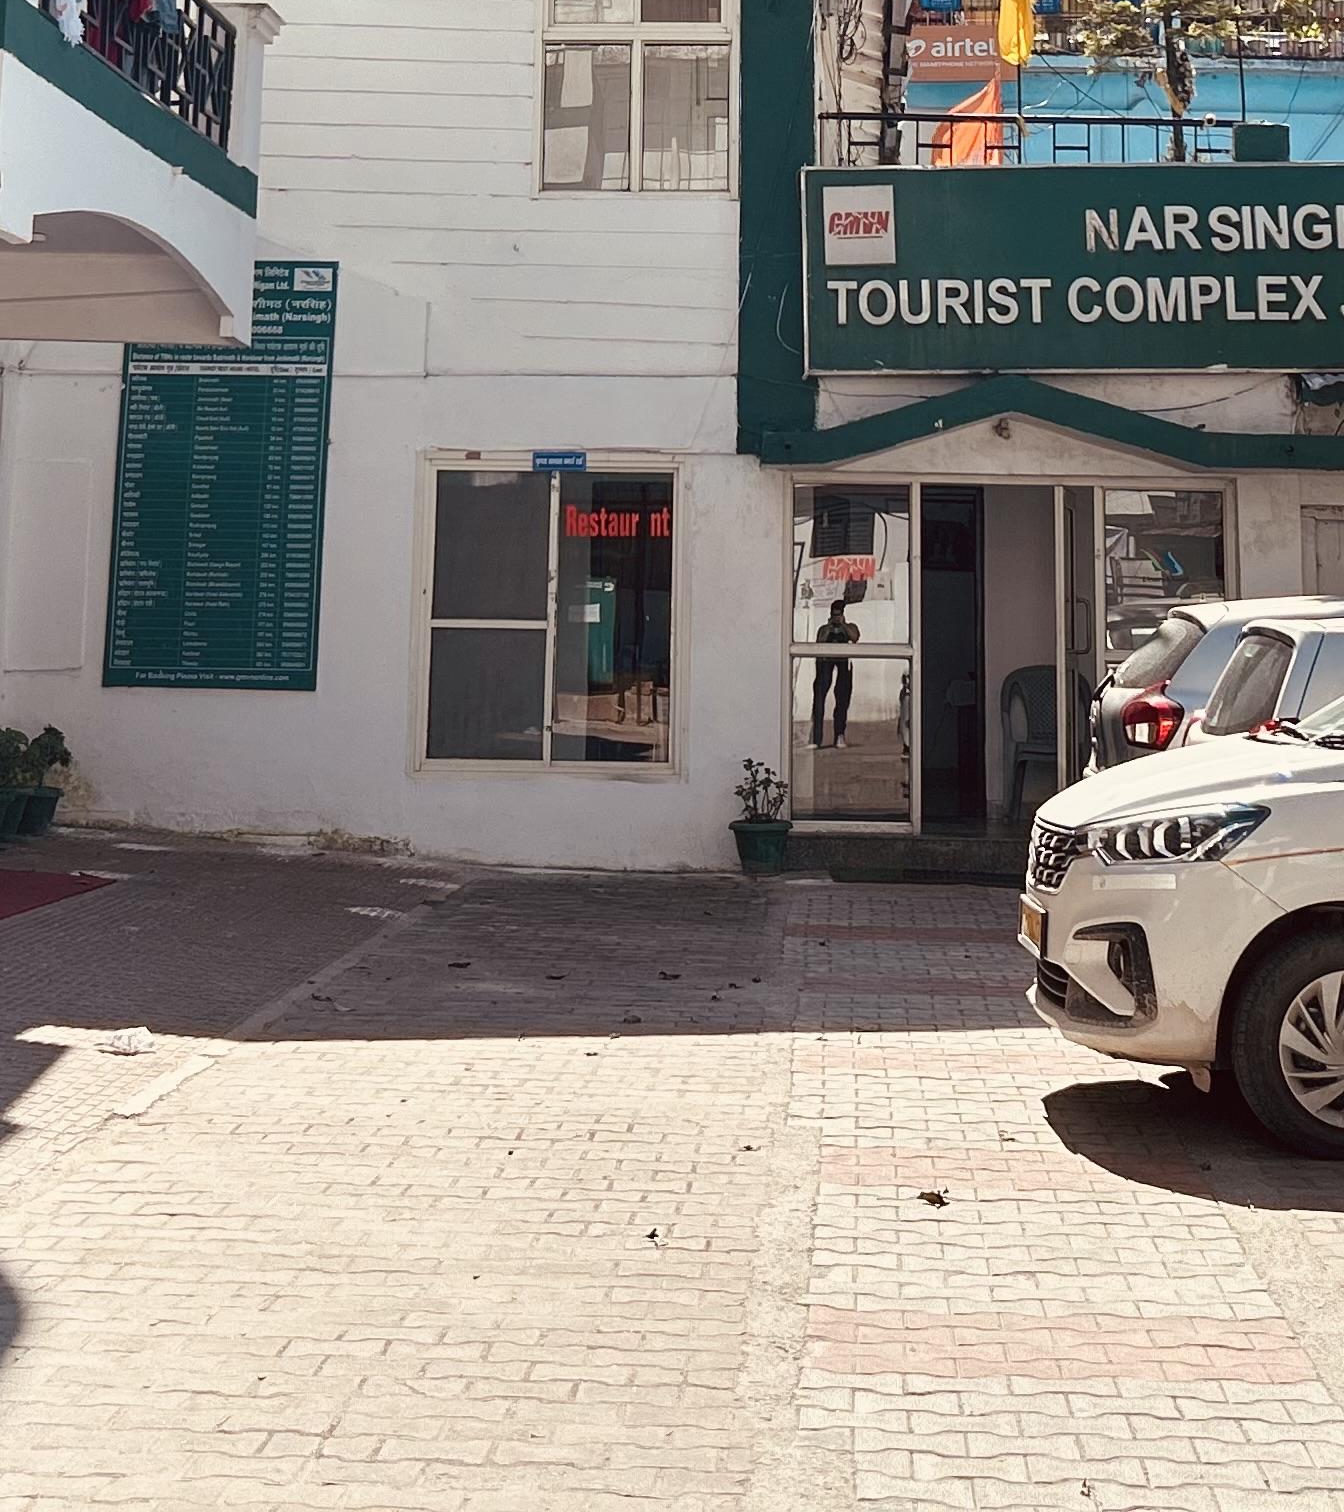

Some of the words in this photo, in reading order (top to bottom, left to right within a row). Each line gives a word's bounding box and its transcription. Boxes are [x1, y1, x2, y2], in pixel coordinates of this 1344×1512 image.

[930, 36, 998, 57] airtel
[828, 210, 890, 236] GMVN
[827, 278, 1051, 325] TOURIST
[1067, 275, 1326, 323] COMPLEX
